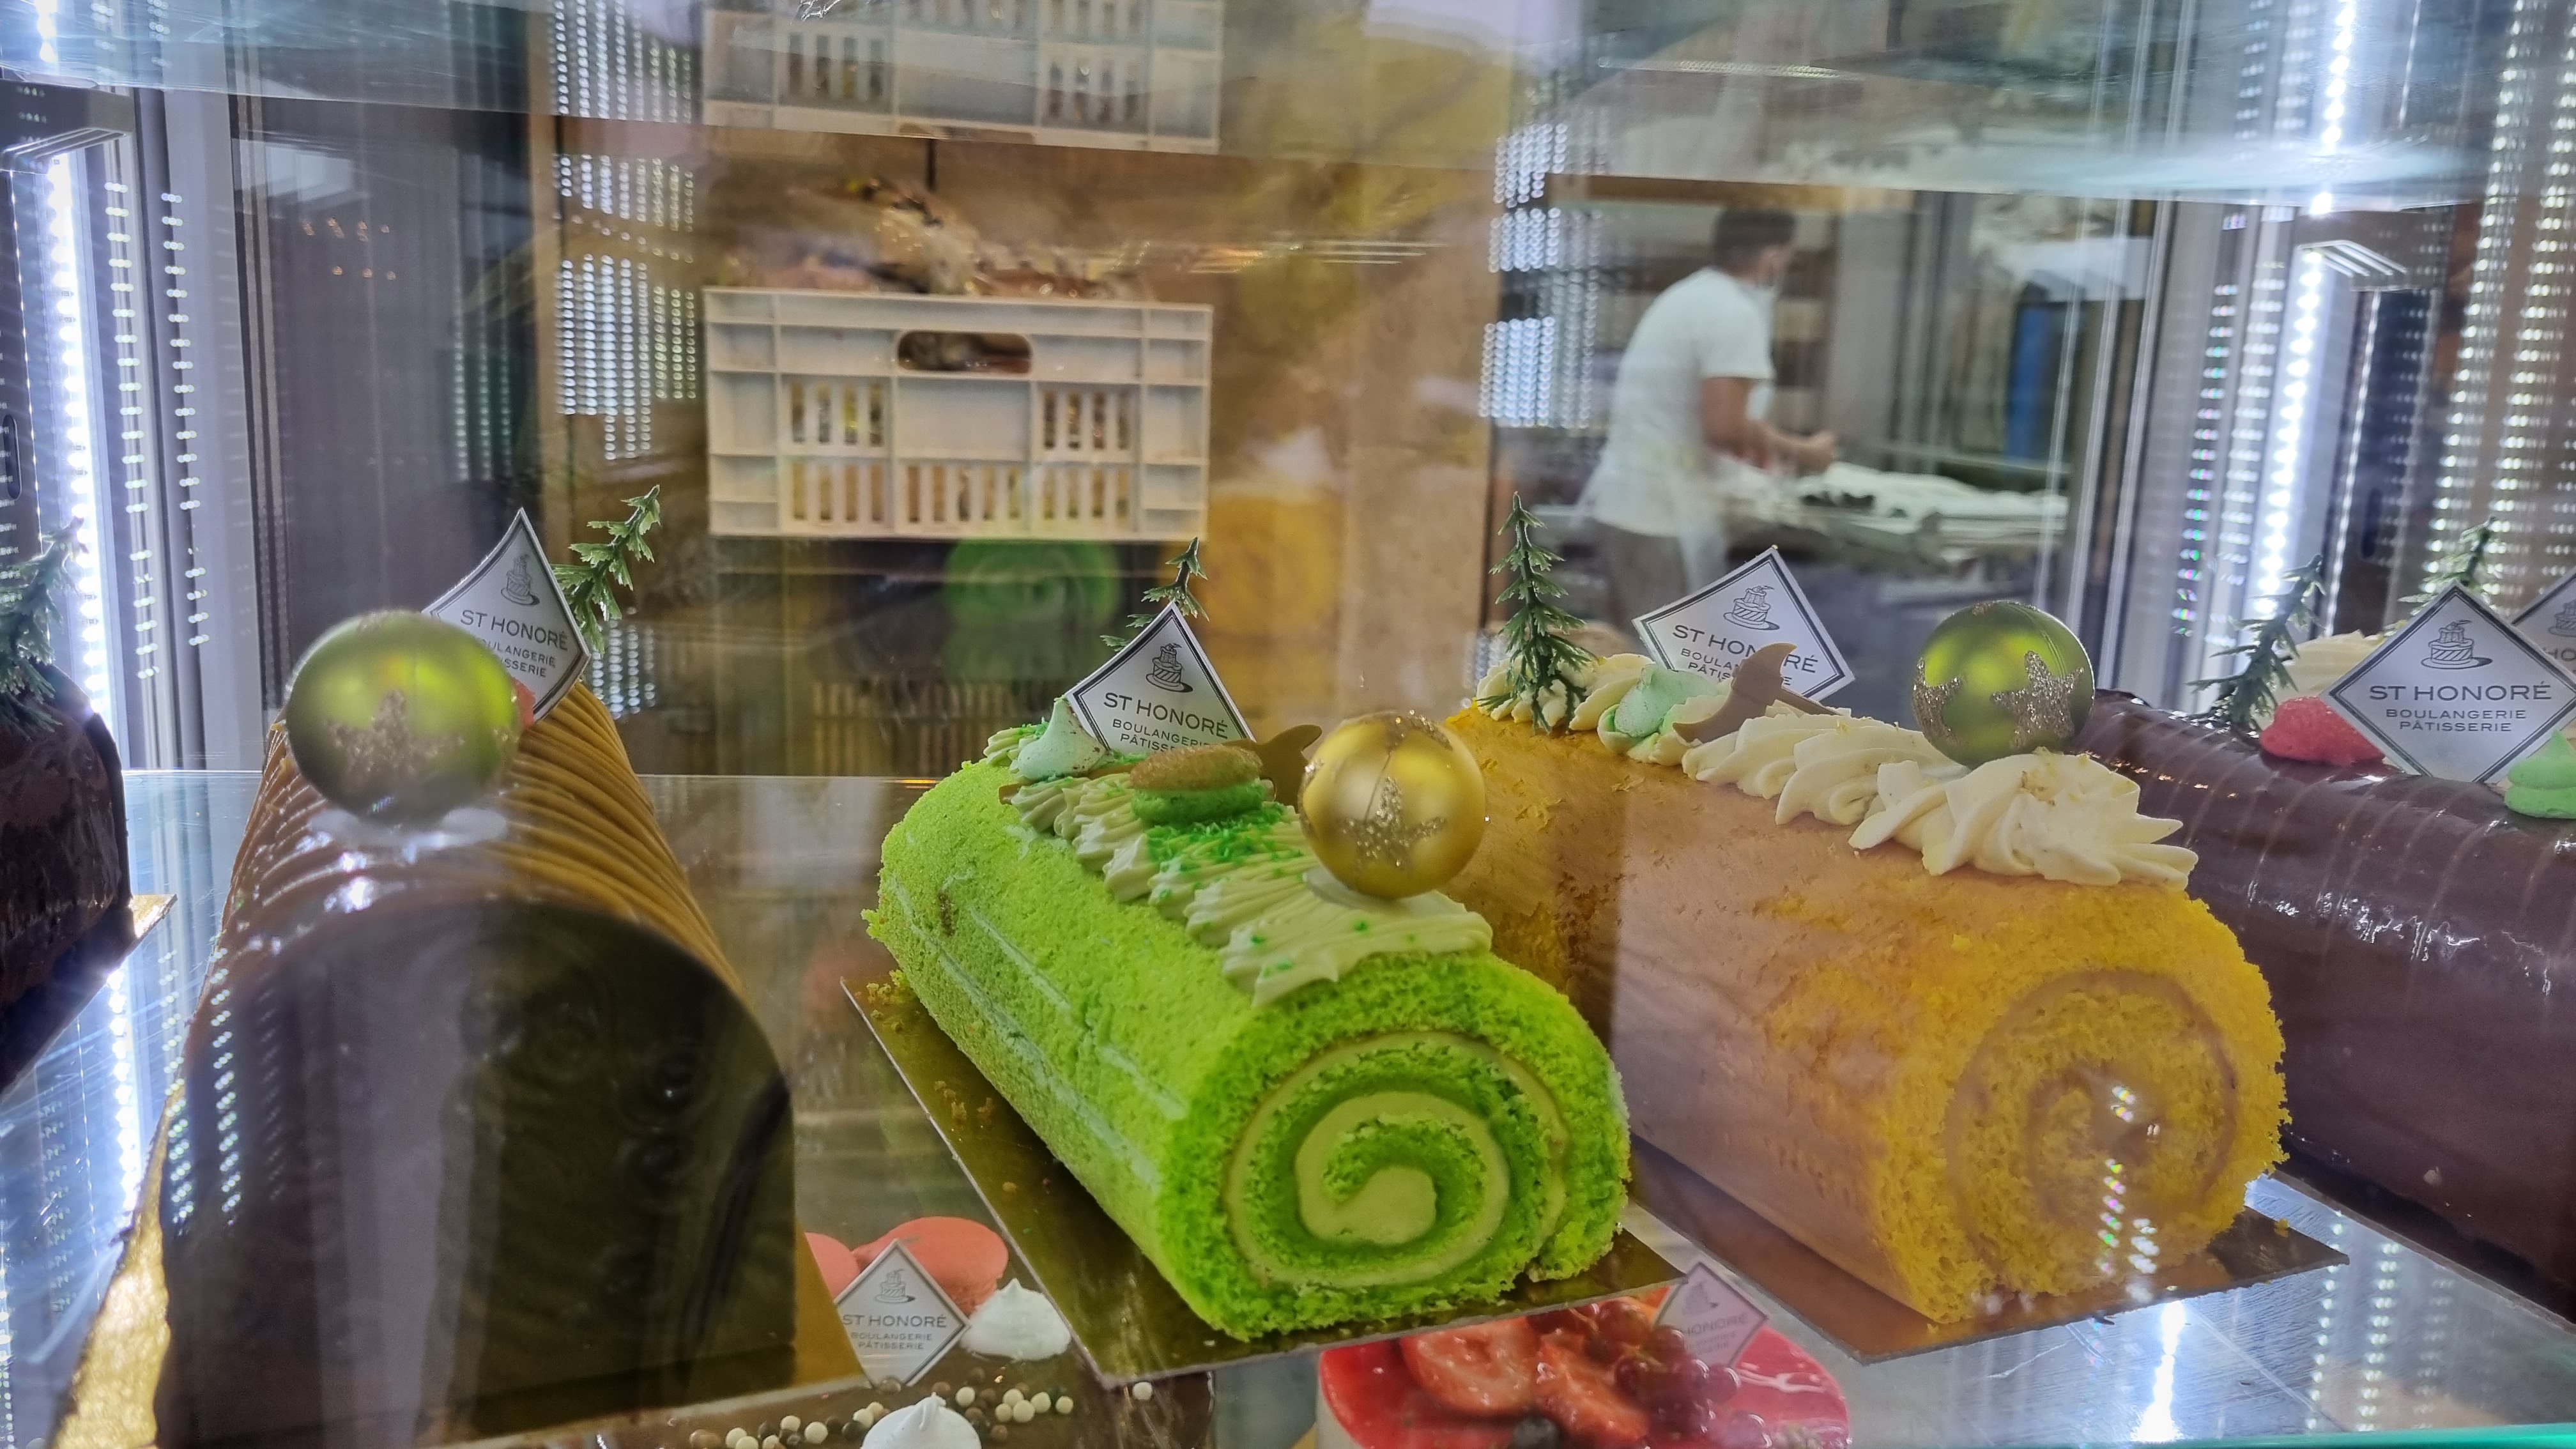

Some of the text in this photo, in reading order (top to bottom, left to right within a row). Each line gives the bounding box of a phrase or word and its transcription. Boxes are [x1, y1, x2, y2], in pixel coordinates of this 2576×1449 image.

[460, 610, 569, 652] ST HONORÉ
[1672, 625, 1705, 643] ST
[481, 639, 556, 668] ULANGERIE
[2370, 680, 2552, 701] ST HONORÉ
[1103, 692, 1228, 740] ST HONORÉ
[2386, 709, 2527, 719] BOULANGERIE
[2400, 720, 2511, 732] PÂTISSERIE
[842, 1314, 947, 1328] ST HONORÉ
[850, 1332, 933, 1340] BOULANGERIE
